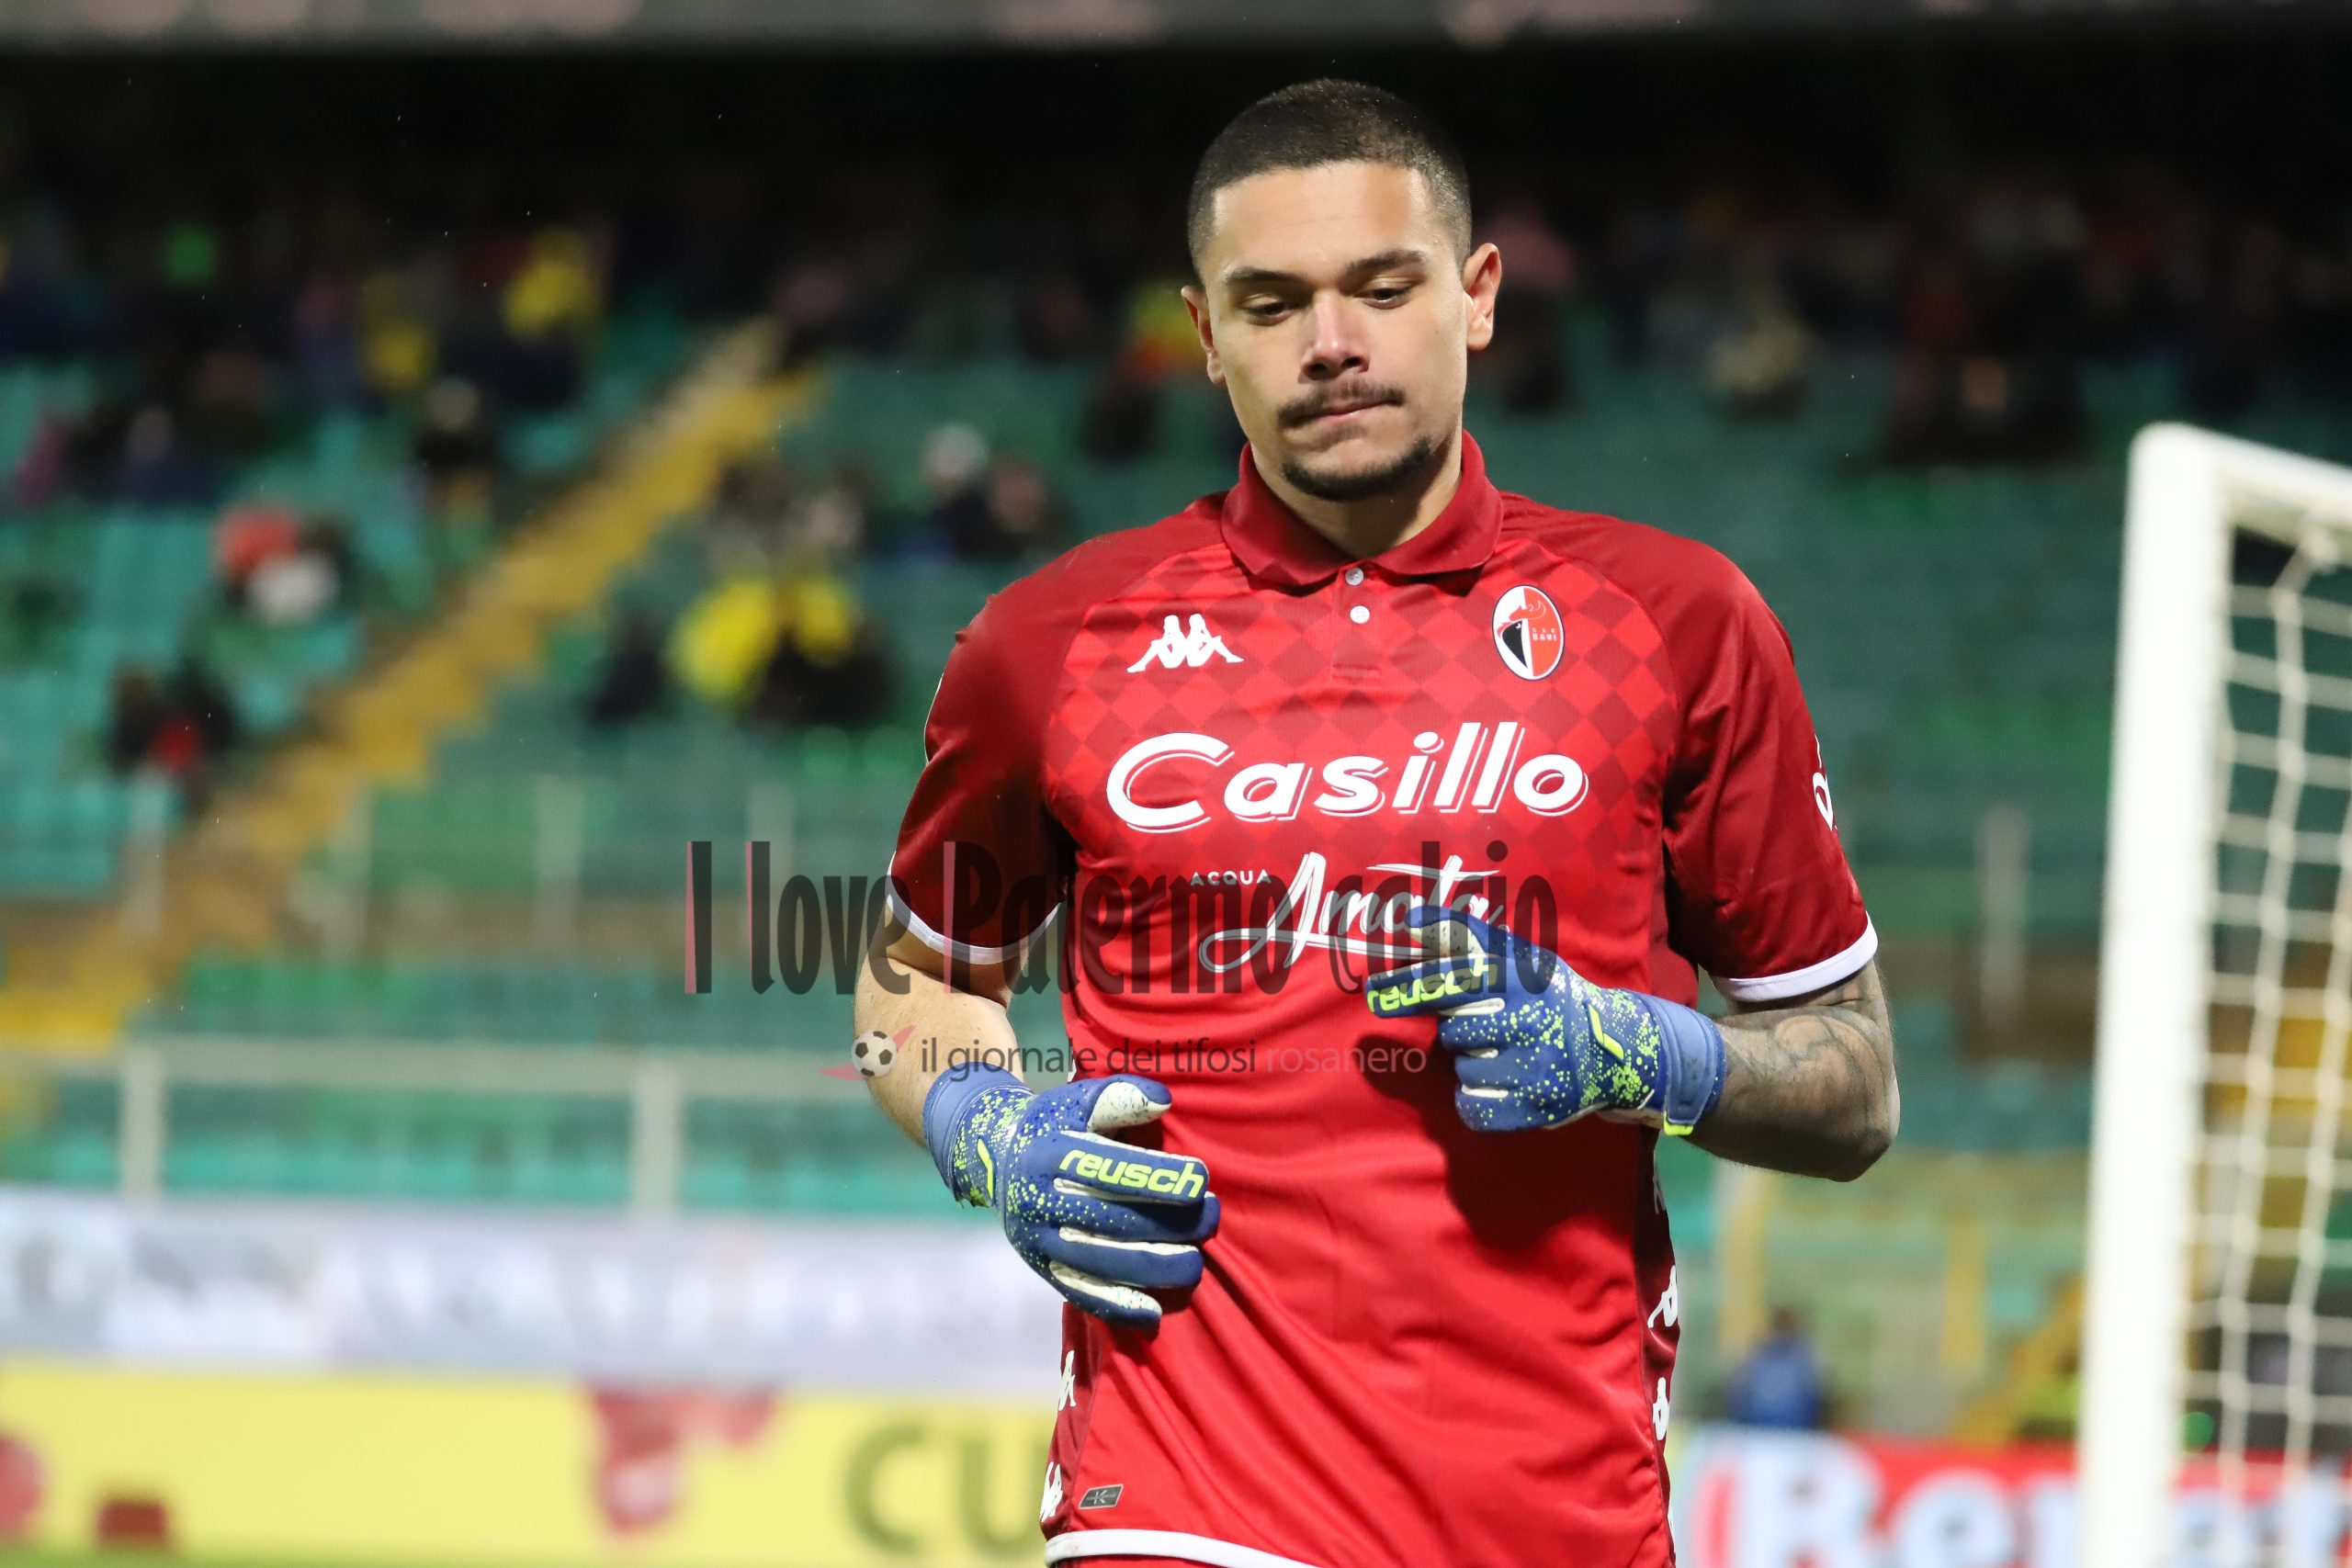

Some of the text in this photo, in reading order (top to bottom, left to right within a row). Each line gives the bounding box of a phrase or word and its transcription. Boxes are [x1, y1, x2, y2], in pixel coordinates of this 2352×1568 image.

[1106, 721, 1589, 833] Casillo
[1190, 869, 1272, 886] ACQUA
[1366, 955, 1498, 1012] reusch
[1058, 1149, 1205, 1199] reusch
